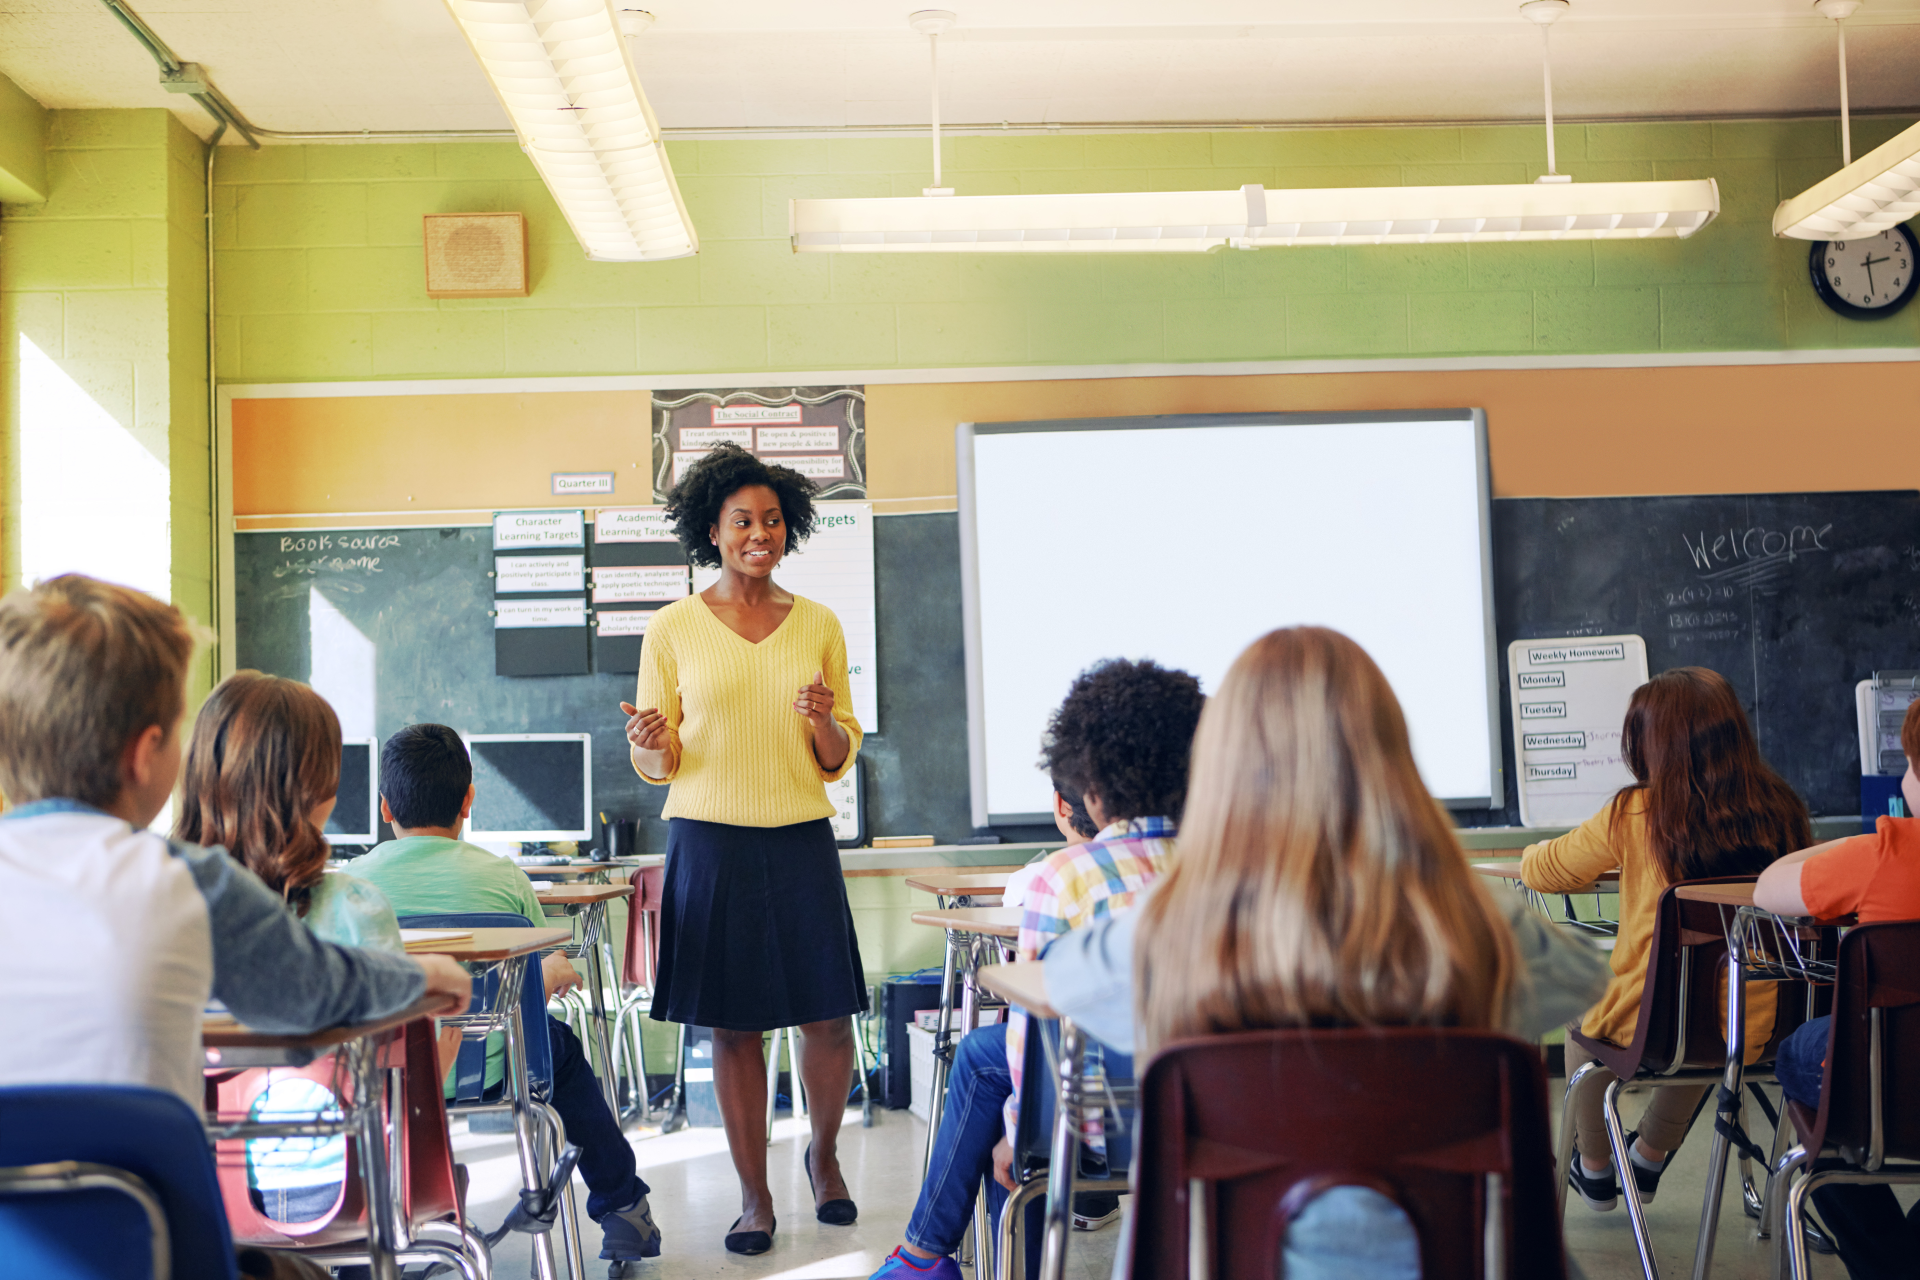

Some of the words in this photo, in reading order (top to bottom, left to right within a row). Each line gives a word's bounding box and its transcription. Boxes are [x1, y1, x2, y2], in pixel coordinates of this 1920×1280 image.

[1834, 241, 1846, 251] 10
[1894, 241, 1902, 252] 2
[1827, 257, 1835, 268] 9
[1900, 258, 1907, 269] 3
[1834, 276, 1841, 287] 8
[1893, 277, 1900, 287] 4
[1863, 294, 1871, 304] 6
[735, 410, 759, 418] Social
[761, 409, 798, 418] Contract
[799, 430, 827, 438] positive
[779, 440, 803, 448] people
[781, 457, 829, 466] responsibility
[558, 479, 596, 489] Quarter
[515, 517, 562, 526] Character
[617, 513, 663, 522] Academic
[815, 514, 856, 528] argets
[499, 531, 541, 541] Learning
[543, 530, 579, 540] Targets
[600, 527, 642, 537] Learning
[644, 527, 671, 537] Targe
[280, 535, 333, 553] Book
[1681, 523, 1833, 570] Welcome
[528, 561, 555, 569] actively
[500, 571, 534, 579] positively
[535, 570, 572, 579] participate
[621, 581, 642, 589] poetic
[643, 580, 681, 588] techniques
[1532, 650, 1567, 661] Weekly
[1569, 647, 1621, 658] Homework
[1522, 674, 1562, 685] Monday
[1523, 705, 1563, 715] Tuesday
[1526, 735, 1582, 747] Wednesday
[1529, 767, 1573, 778] Thursday
[841, 779, 850, 788] 50
[845, 796, 855, 804] 45
[841, 812, 851, 820] 40
